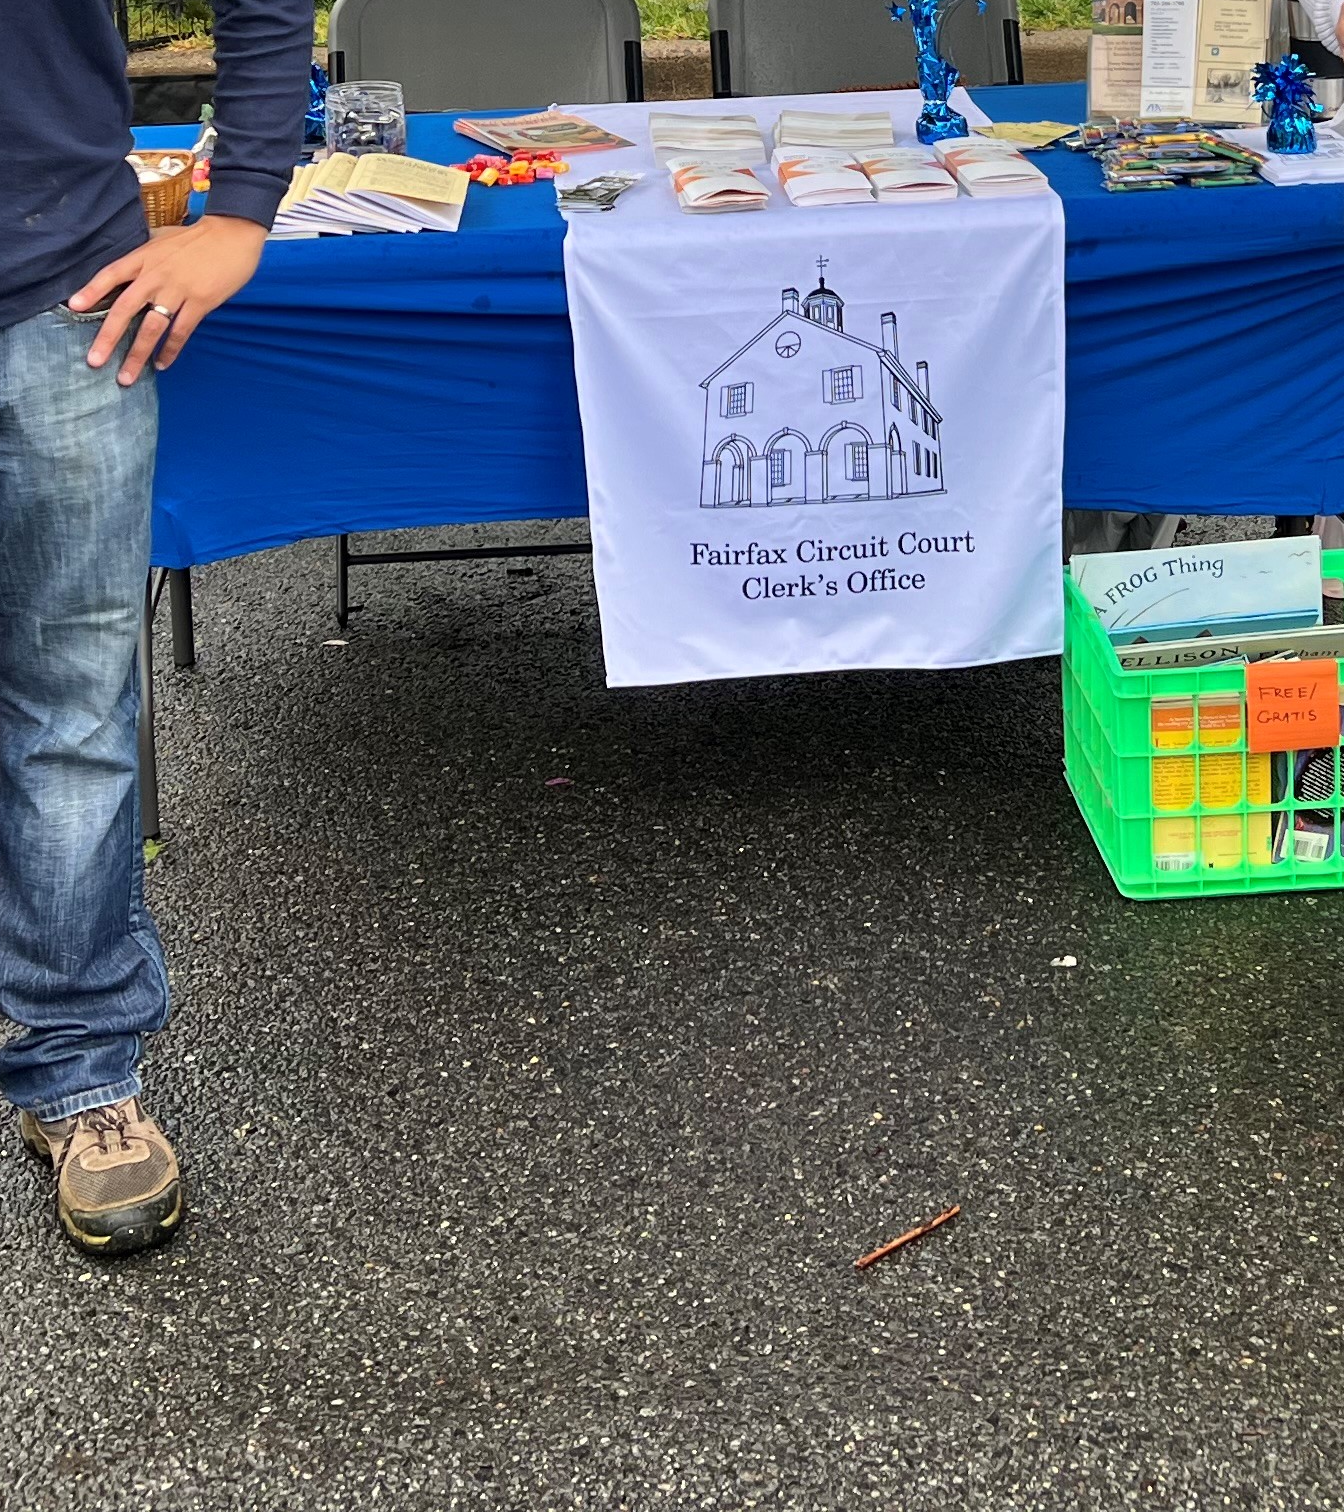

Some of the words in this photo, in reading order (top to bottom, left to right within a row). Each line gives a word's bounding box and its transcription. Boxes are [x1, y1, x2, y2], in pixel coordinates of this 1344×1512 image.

[689, 541, 788, 566] Fairfax
[795, 535, 890, 564] Circuit
[897, 530, 976, 556] Court
[846, 567, 926, 594] Office
[1093, 605, 1107, 618] A
[1104, 566, 1158, 605] FROG
[1162, 554, 1224, 578] Thing
[1120, 645, 1241, 668] ELLISON
[1258, 682, 1318, 702] FREE/
[1256, 709, 1318, 725] GRATIS
